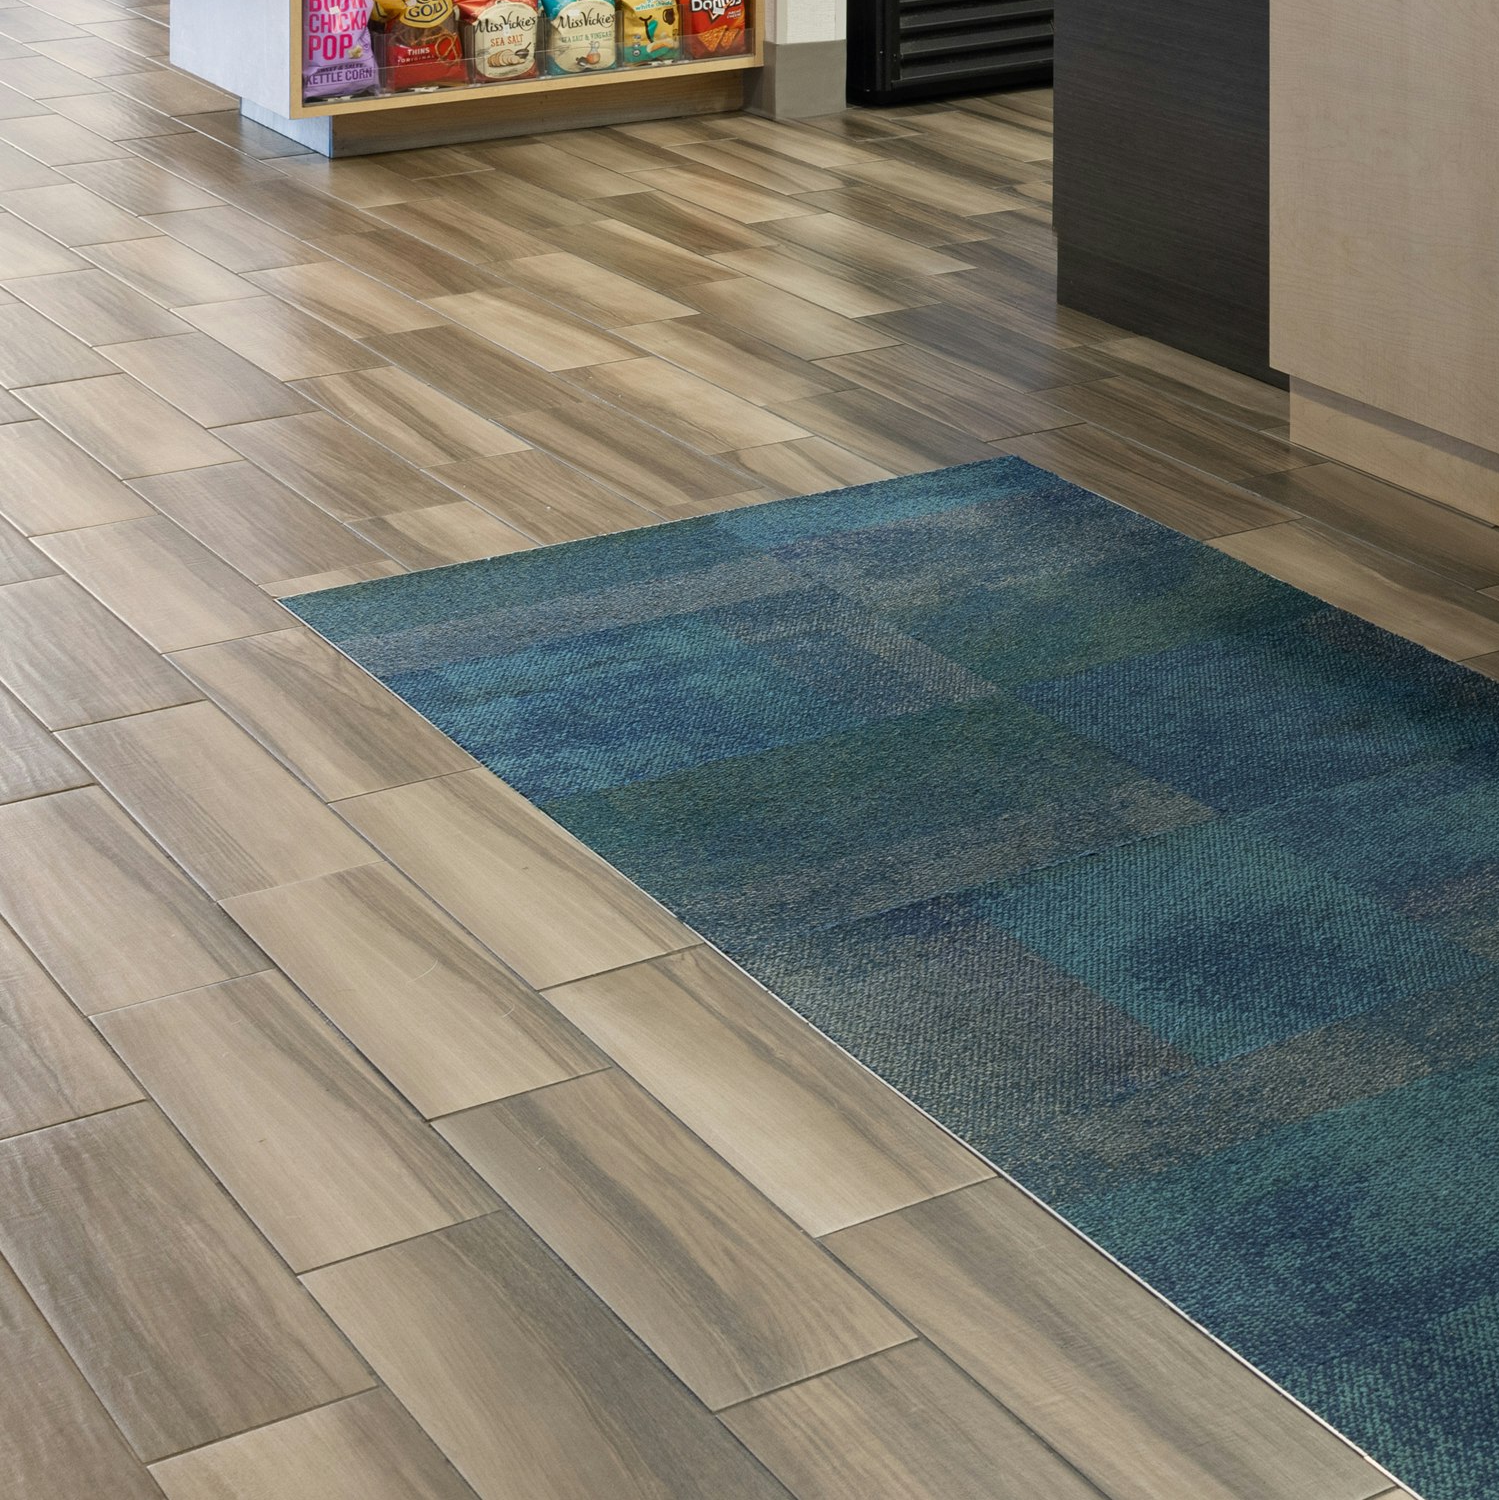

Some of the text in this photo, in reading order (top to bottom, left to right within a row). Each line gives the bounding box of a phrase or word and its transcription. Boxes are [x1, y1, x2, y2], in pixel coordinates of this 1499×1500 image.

[309, 10, 368, 34] CHICKA
[475, 11, 536, 34] Miss Vickie's
[558, 15, 581, 29] Miss
[490, 34, 524, 47] SEA SALT
[573, 34, 585, 42] SALT
[308, 34, 353, 62] POP
[407, 47, 430, 56] THINS
[306, 67, 373, 86] KETTLE CORN
